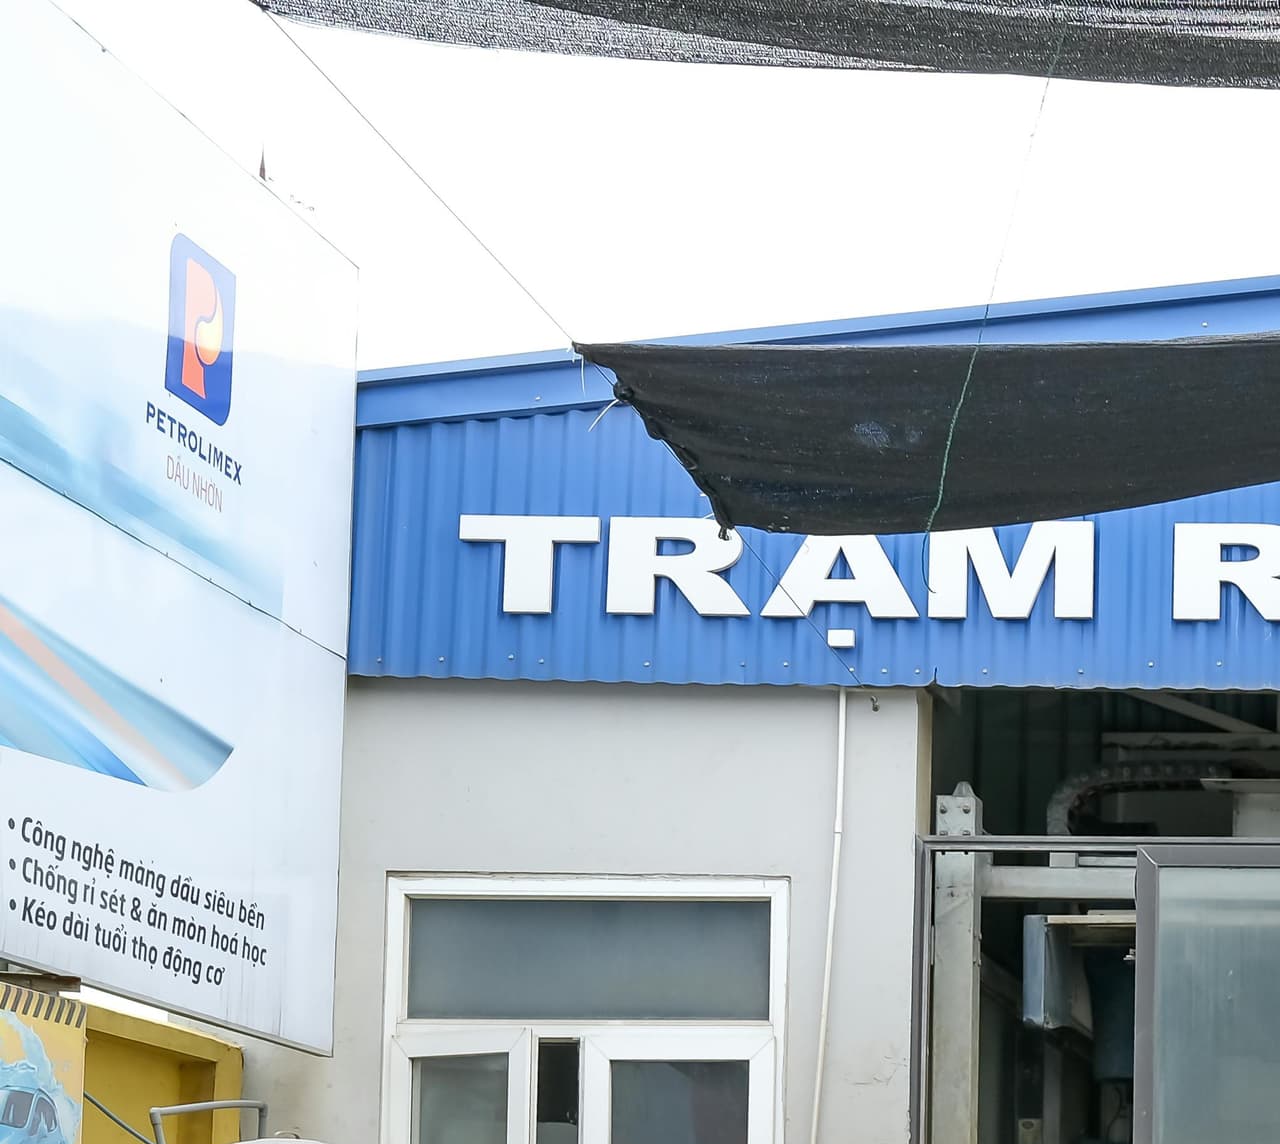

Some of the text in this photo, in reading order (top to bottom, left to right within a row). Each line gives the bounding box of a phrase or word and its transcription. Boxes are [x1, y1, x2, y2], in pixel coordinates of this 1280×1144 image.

[146, 400, 243, 486] PETROLIMEX
[459, 514, 1095, 648] TRẠM
[21, 816, 265, 931] Công nghệ màng dầu siêu bền
[22, 856, 267, 967] Chống rỉ sét & ăn mòn hoá học
[22, 896, 226, 986] Kéo dài tuổi thọ động cơ
